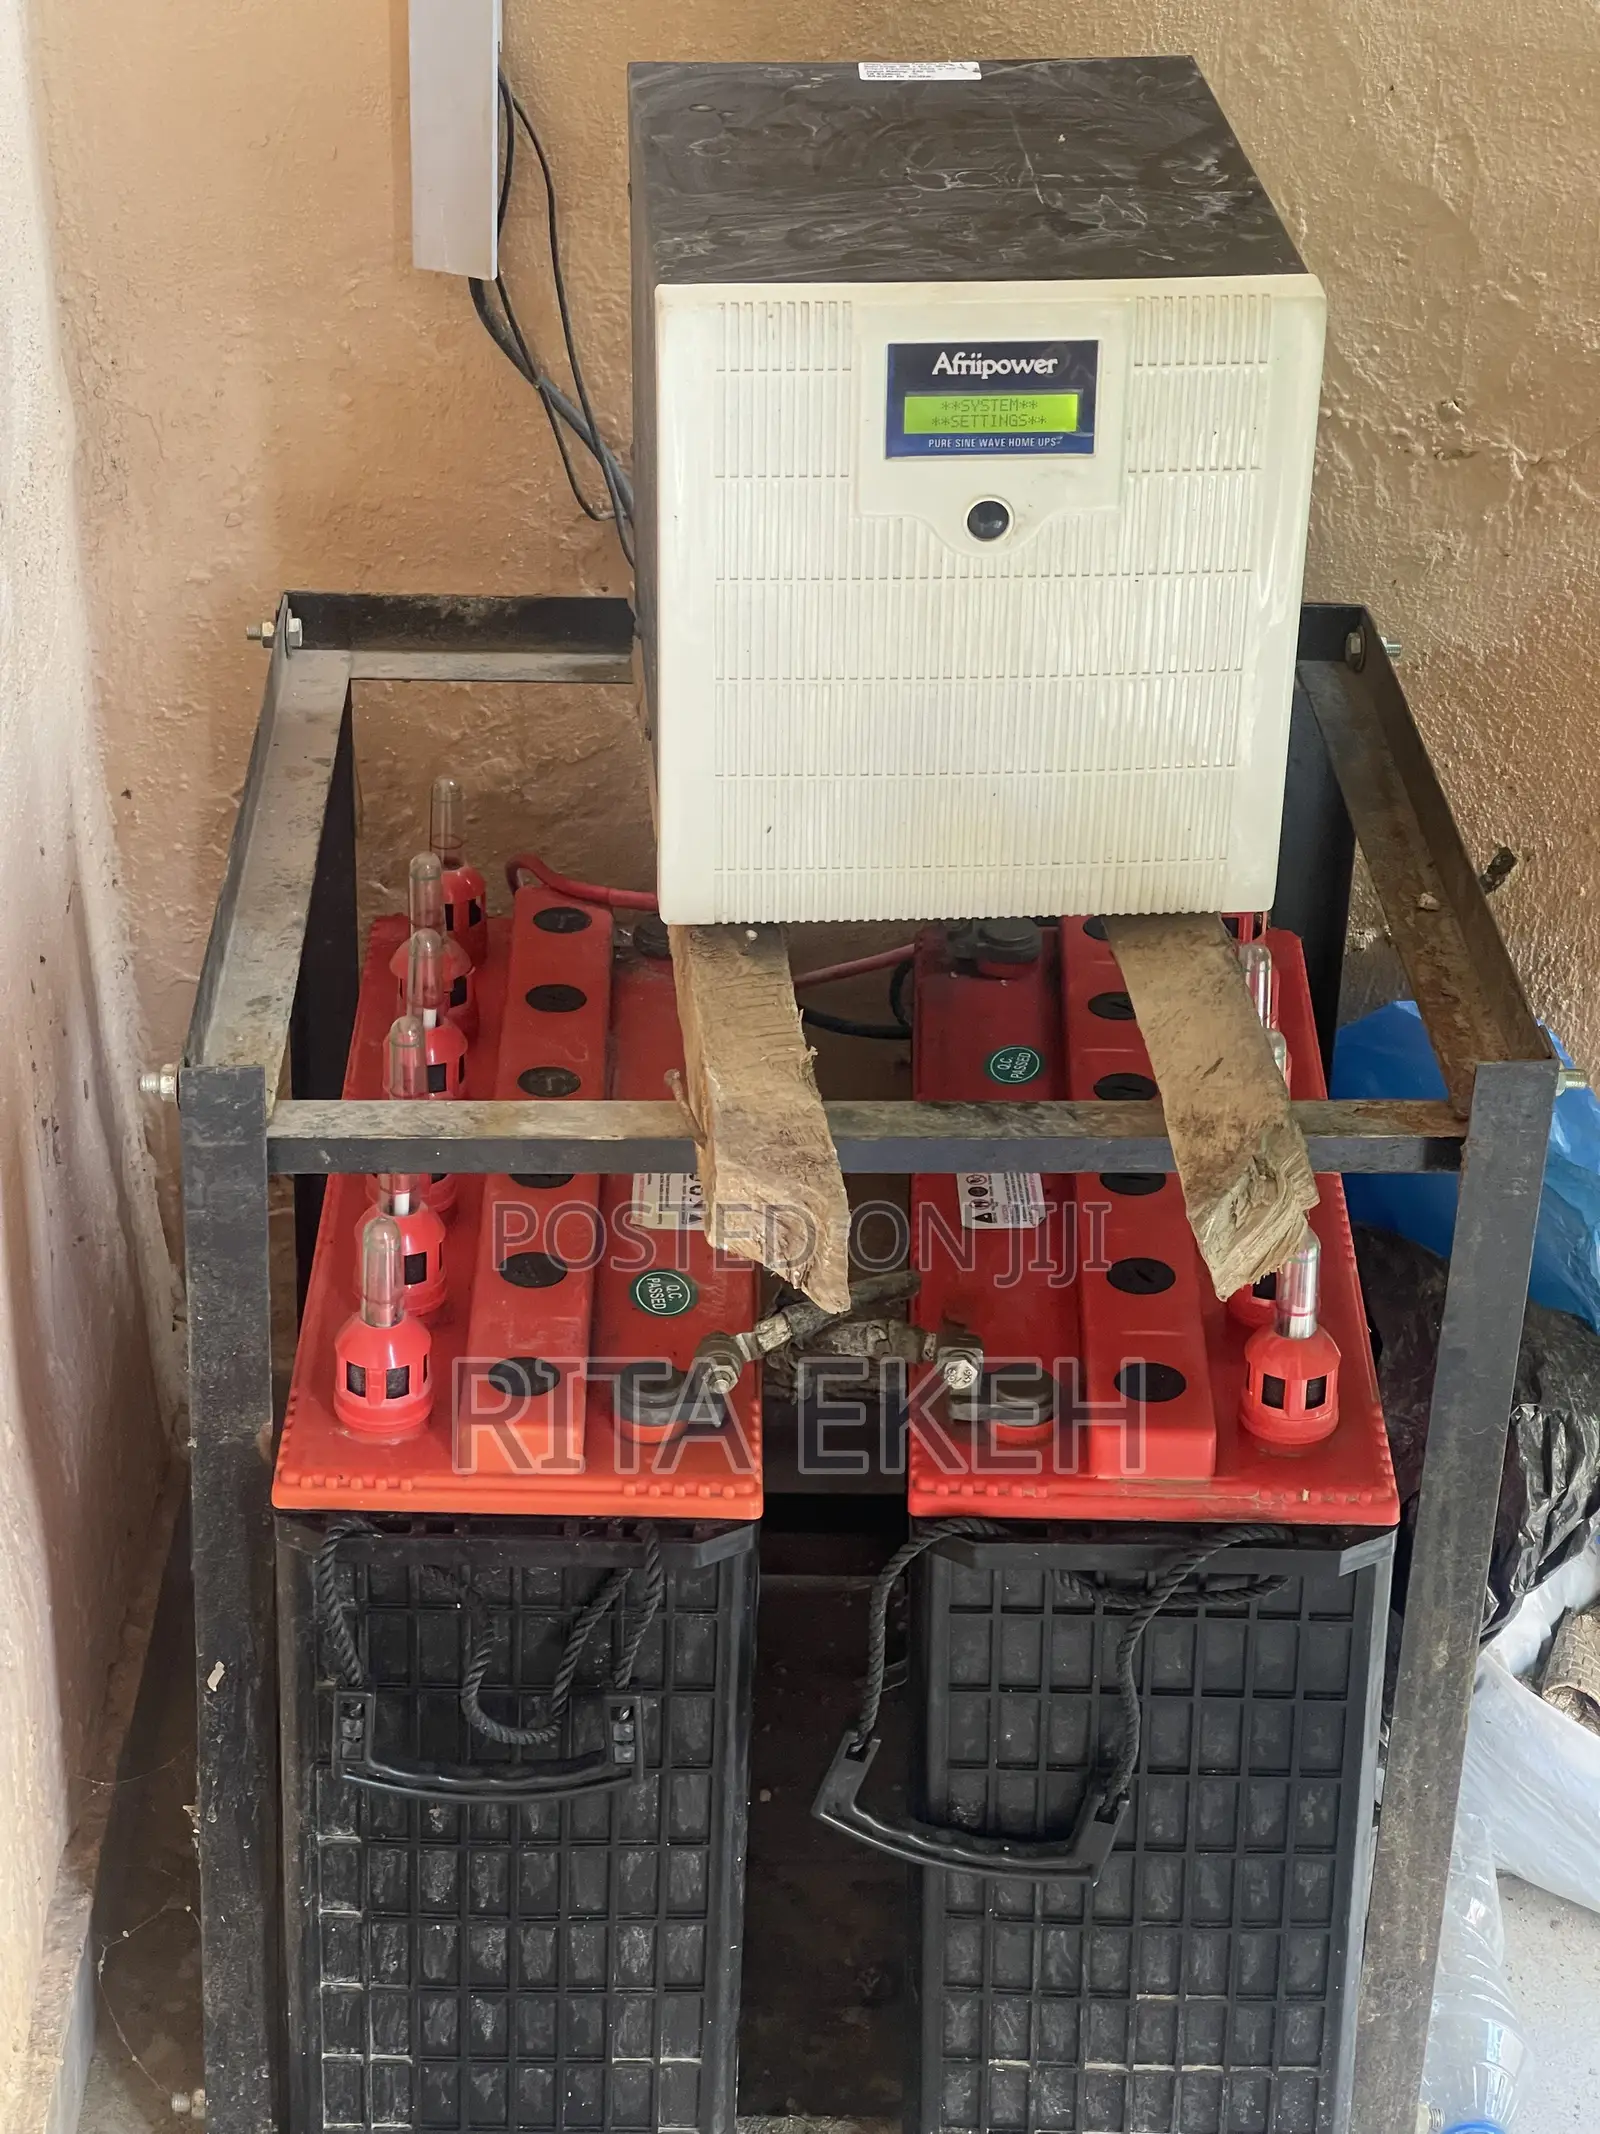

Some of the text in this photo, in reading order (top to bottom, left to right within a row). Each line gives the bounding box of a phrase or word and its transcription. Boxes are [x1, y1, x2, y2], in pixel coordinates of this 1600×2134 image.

[931, 351, 1058, 380] Afriipower
[928, 439, 951, 448] PURE
[955, 438, 976, 447] SINE
[979, 438, 1006, 447] WAVE
[1008, 437, 1035, 447] HOME
[1010, 1052, 1031, 1079] PASSED
[646, 1277, 667, 1310] PASSED
